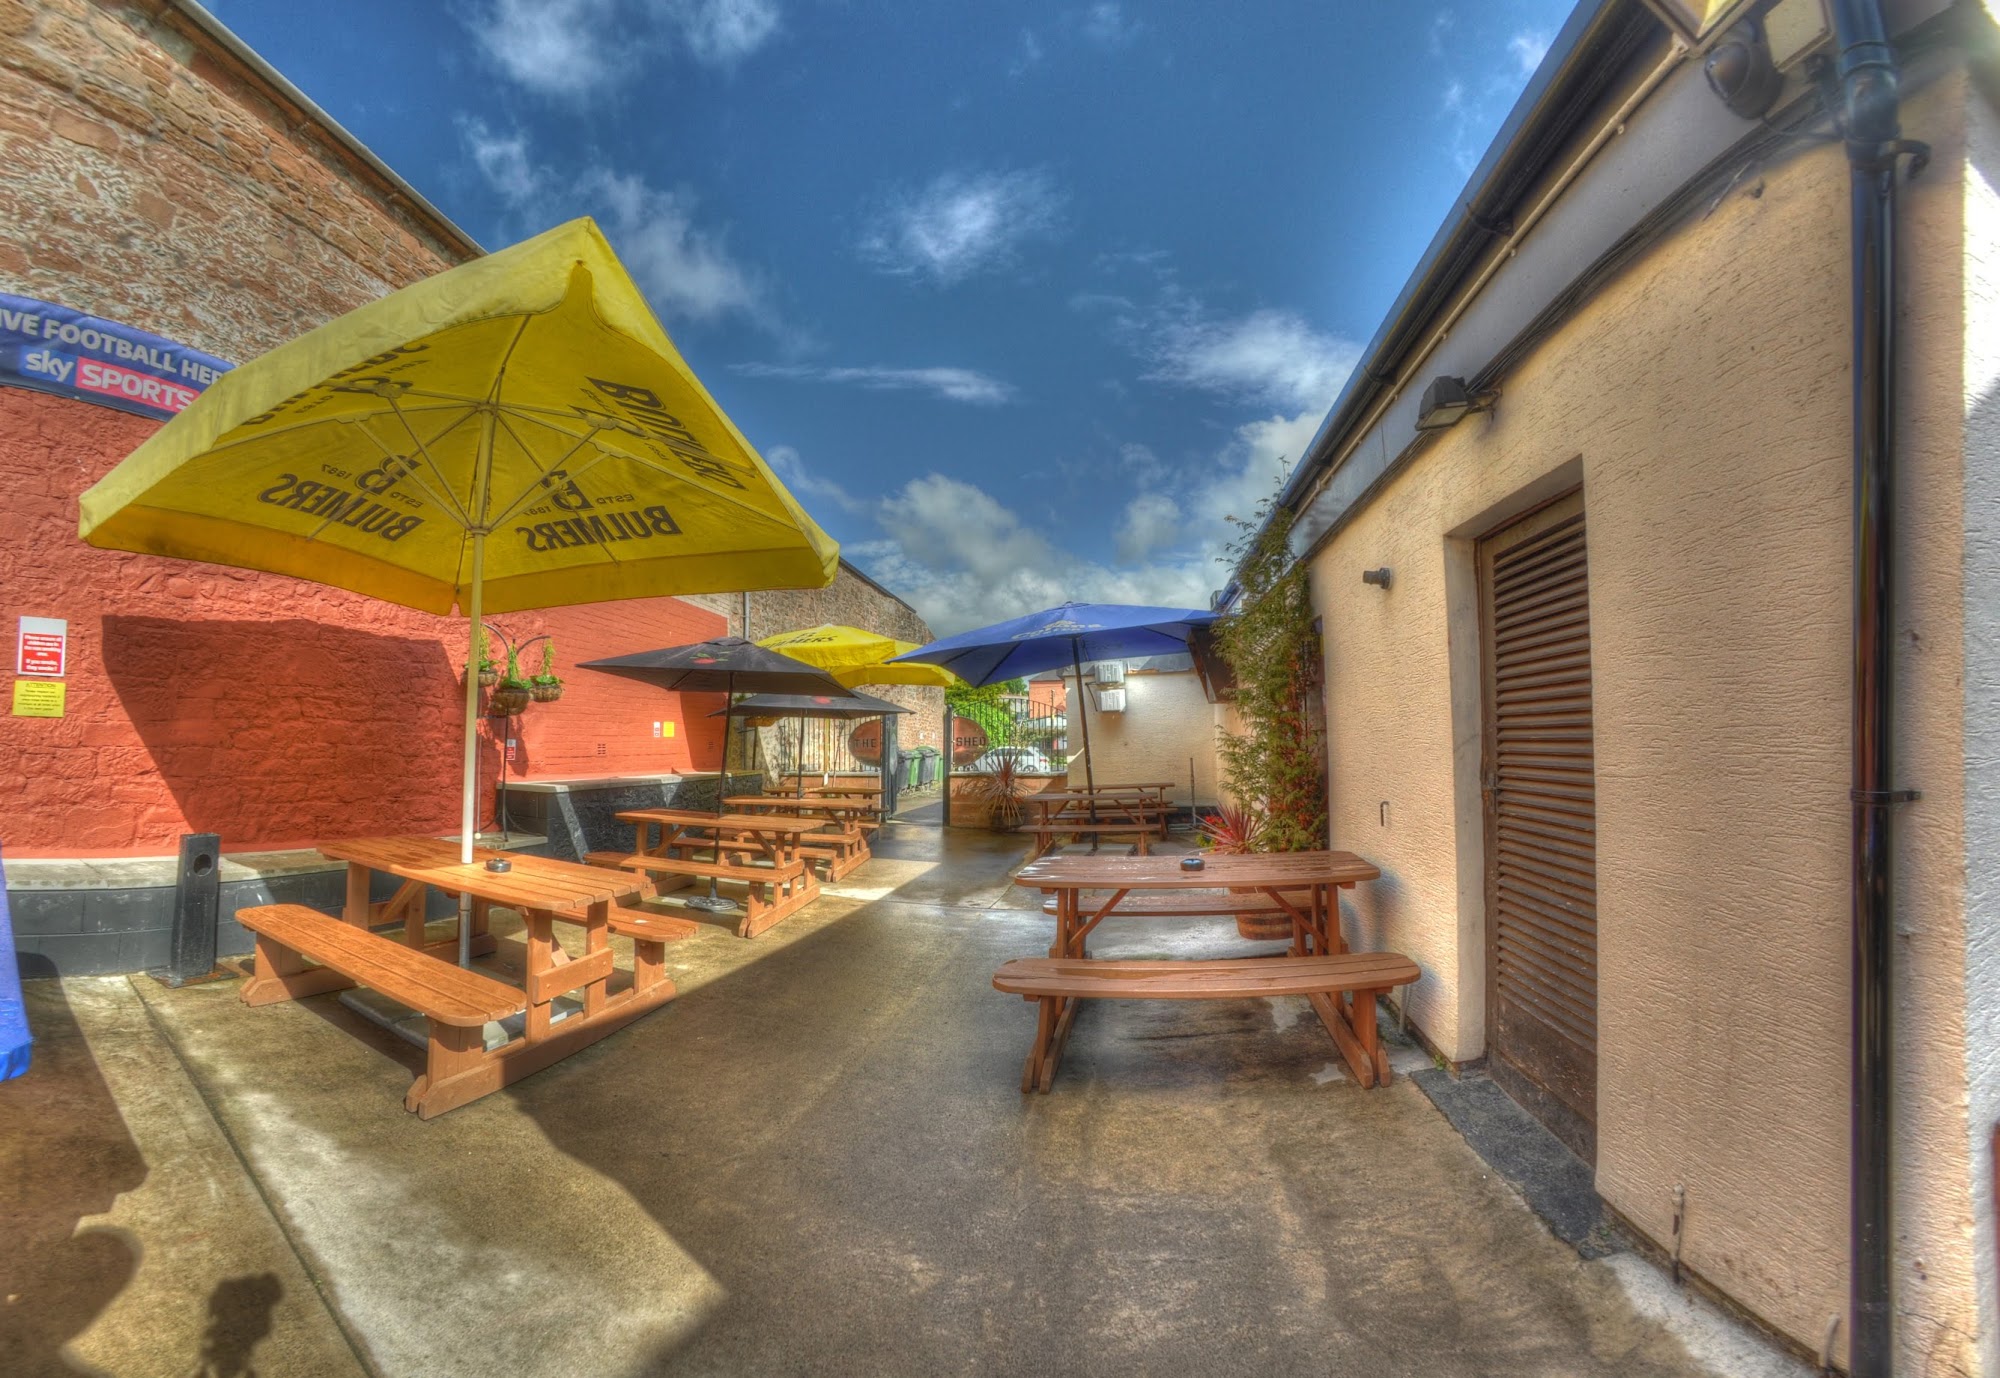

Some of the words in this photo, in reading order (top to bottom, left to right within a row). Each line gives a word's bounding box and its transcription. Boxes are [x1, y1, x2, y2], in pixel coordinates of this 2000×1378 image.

[44, 319, 176, 373] FOOTBALL
[26, 350, 75, 382] sky
[82, 364, 194, 411] SPORTS
[854, 738, 877, 748] THE
[956, 736, 986, 747] SHED
